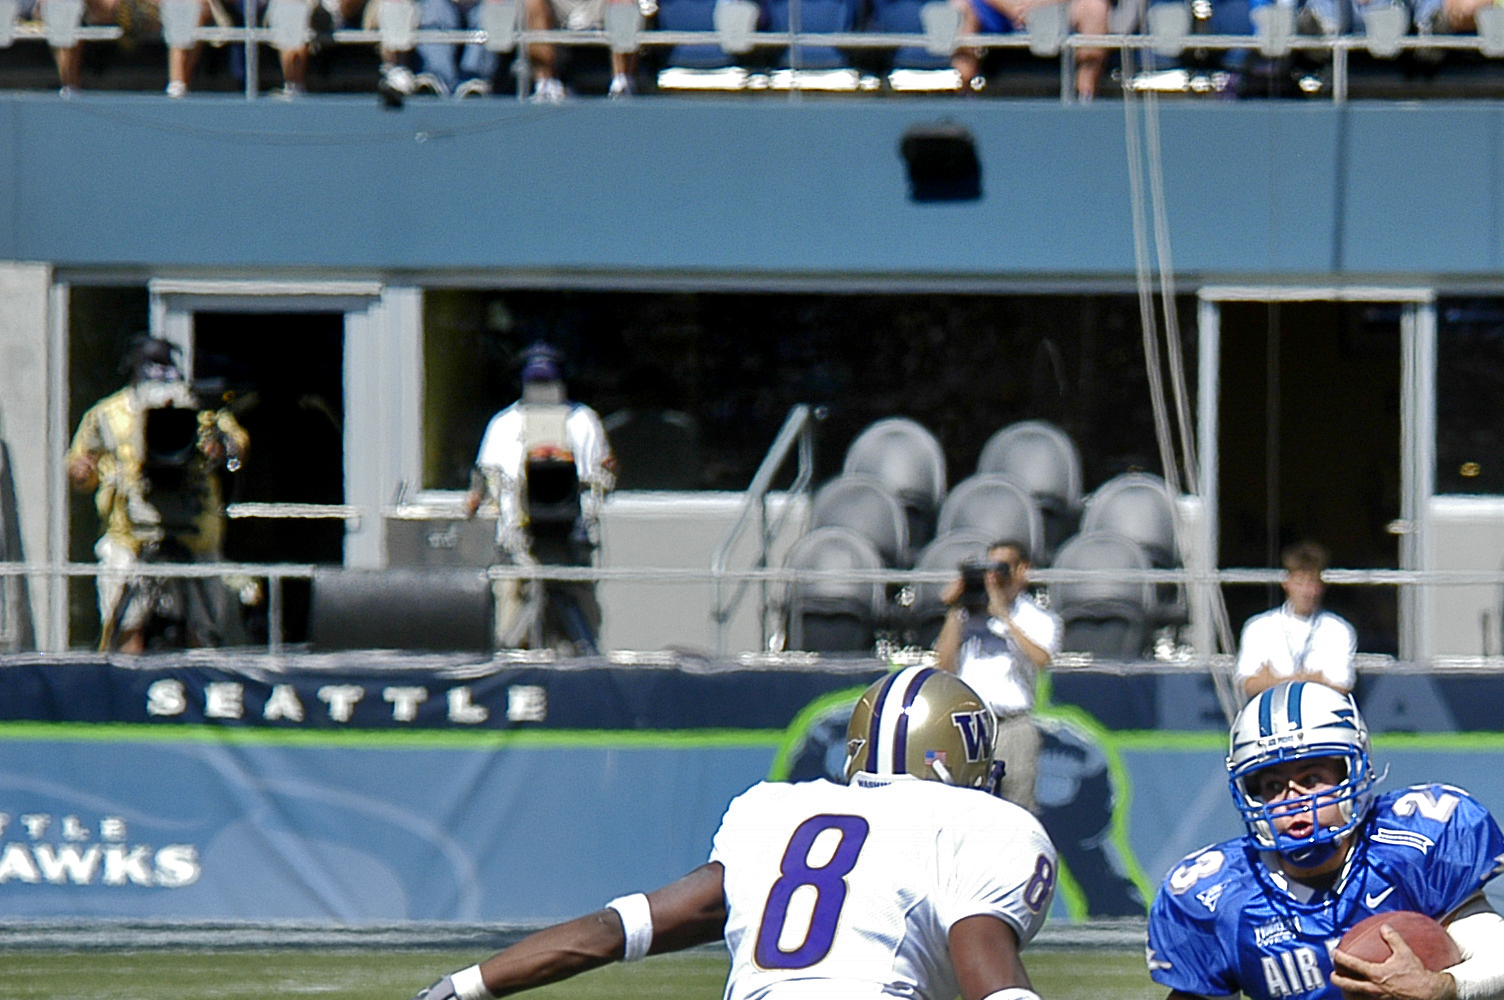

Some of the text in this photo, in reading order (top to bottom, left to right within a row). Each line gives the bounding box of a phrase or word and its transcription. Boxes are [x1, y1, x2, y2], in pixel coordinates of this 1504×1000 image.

[147, 678, 548, 724] SEATTLE
[951, 709, 992, 763] W
[754, 813, 871, 971] 8
[1024, 853, 1056, 915] 8
[1260, 946, 1326, 998] AIR
